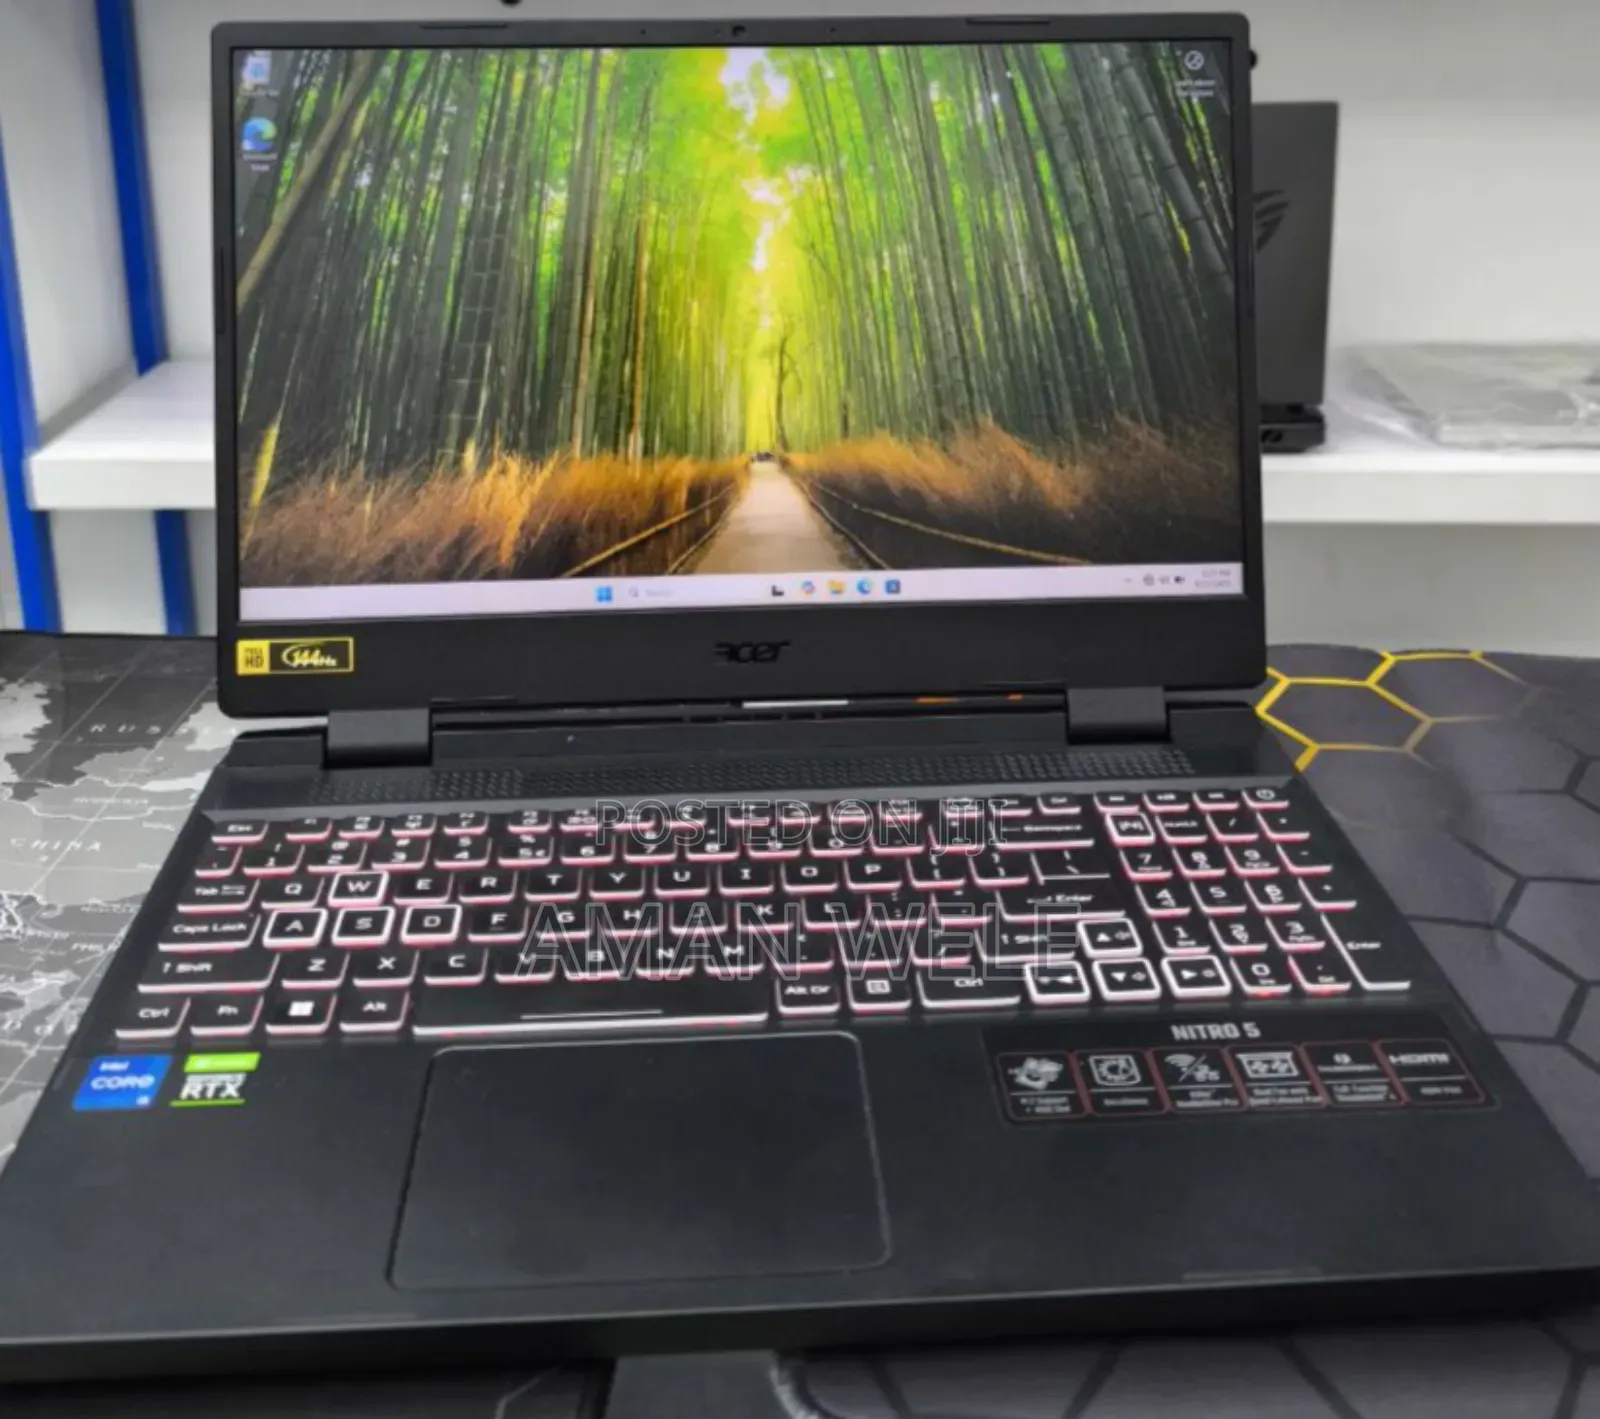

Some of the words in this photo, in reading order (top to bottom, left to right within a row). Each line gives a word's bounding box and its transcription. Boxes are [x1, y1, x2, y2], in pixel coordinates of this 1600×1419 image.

[714, 641, 791, 664] acer
[1140, 853, 1152, 865] 7
[1191, 852, 1207, 863] 8
[1244, 850, 1261, 861] 9
[739, 868, 752, 880] I
[864, 863, 882, 874] P
[480, 876, 497, 888] R
[547, 874, 562, 885] T
[609, 872, 626, 883] Y
[673, 871, 690, 882] U
[284, 883, 303, 894] Q
[347, 880, 371, 892] W
[416, 878, 432, 890] E
[1156, 888, 1173, 900] 4
[1209, 886, 1228, 899] 5
[623, 910, 642, 921] H
[757, 904, 774, 916] K
[423, 915, 441, 928] D
[491, 913, 508, 926] F
[557, 911, 575, 924] G
[173, 922, 207, 935] Caps
[212, 921, 247, 932] Lock
[286, 919, 304, 932] A
[355, 918, 374, 930] S
[1286, 921, 1304, 934] 3
[1174, 926, 1188, 939] 1
[657, 948, 674, 959] N
[724, 945, 745, 957] M
[308, 958, 326, 972] Z
[378, 956, 396, 970] X
[448, 956, 466, 968] C
[1251, 963, 1270, 976] 0
[954, 978, 983, 988] Ctrl
[138, 1006, 170, 1019] Ctrl
[217, 1006, 239, 1016] Fn
[363, 1002, 387, 1012] Alt
[1170, 1022, 1241, 1041] NITRO
[1242, 1022, 1262, 1039] 5
[179, 1082, 242, 1100] RTX
